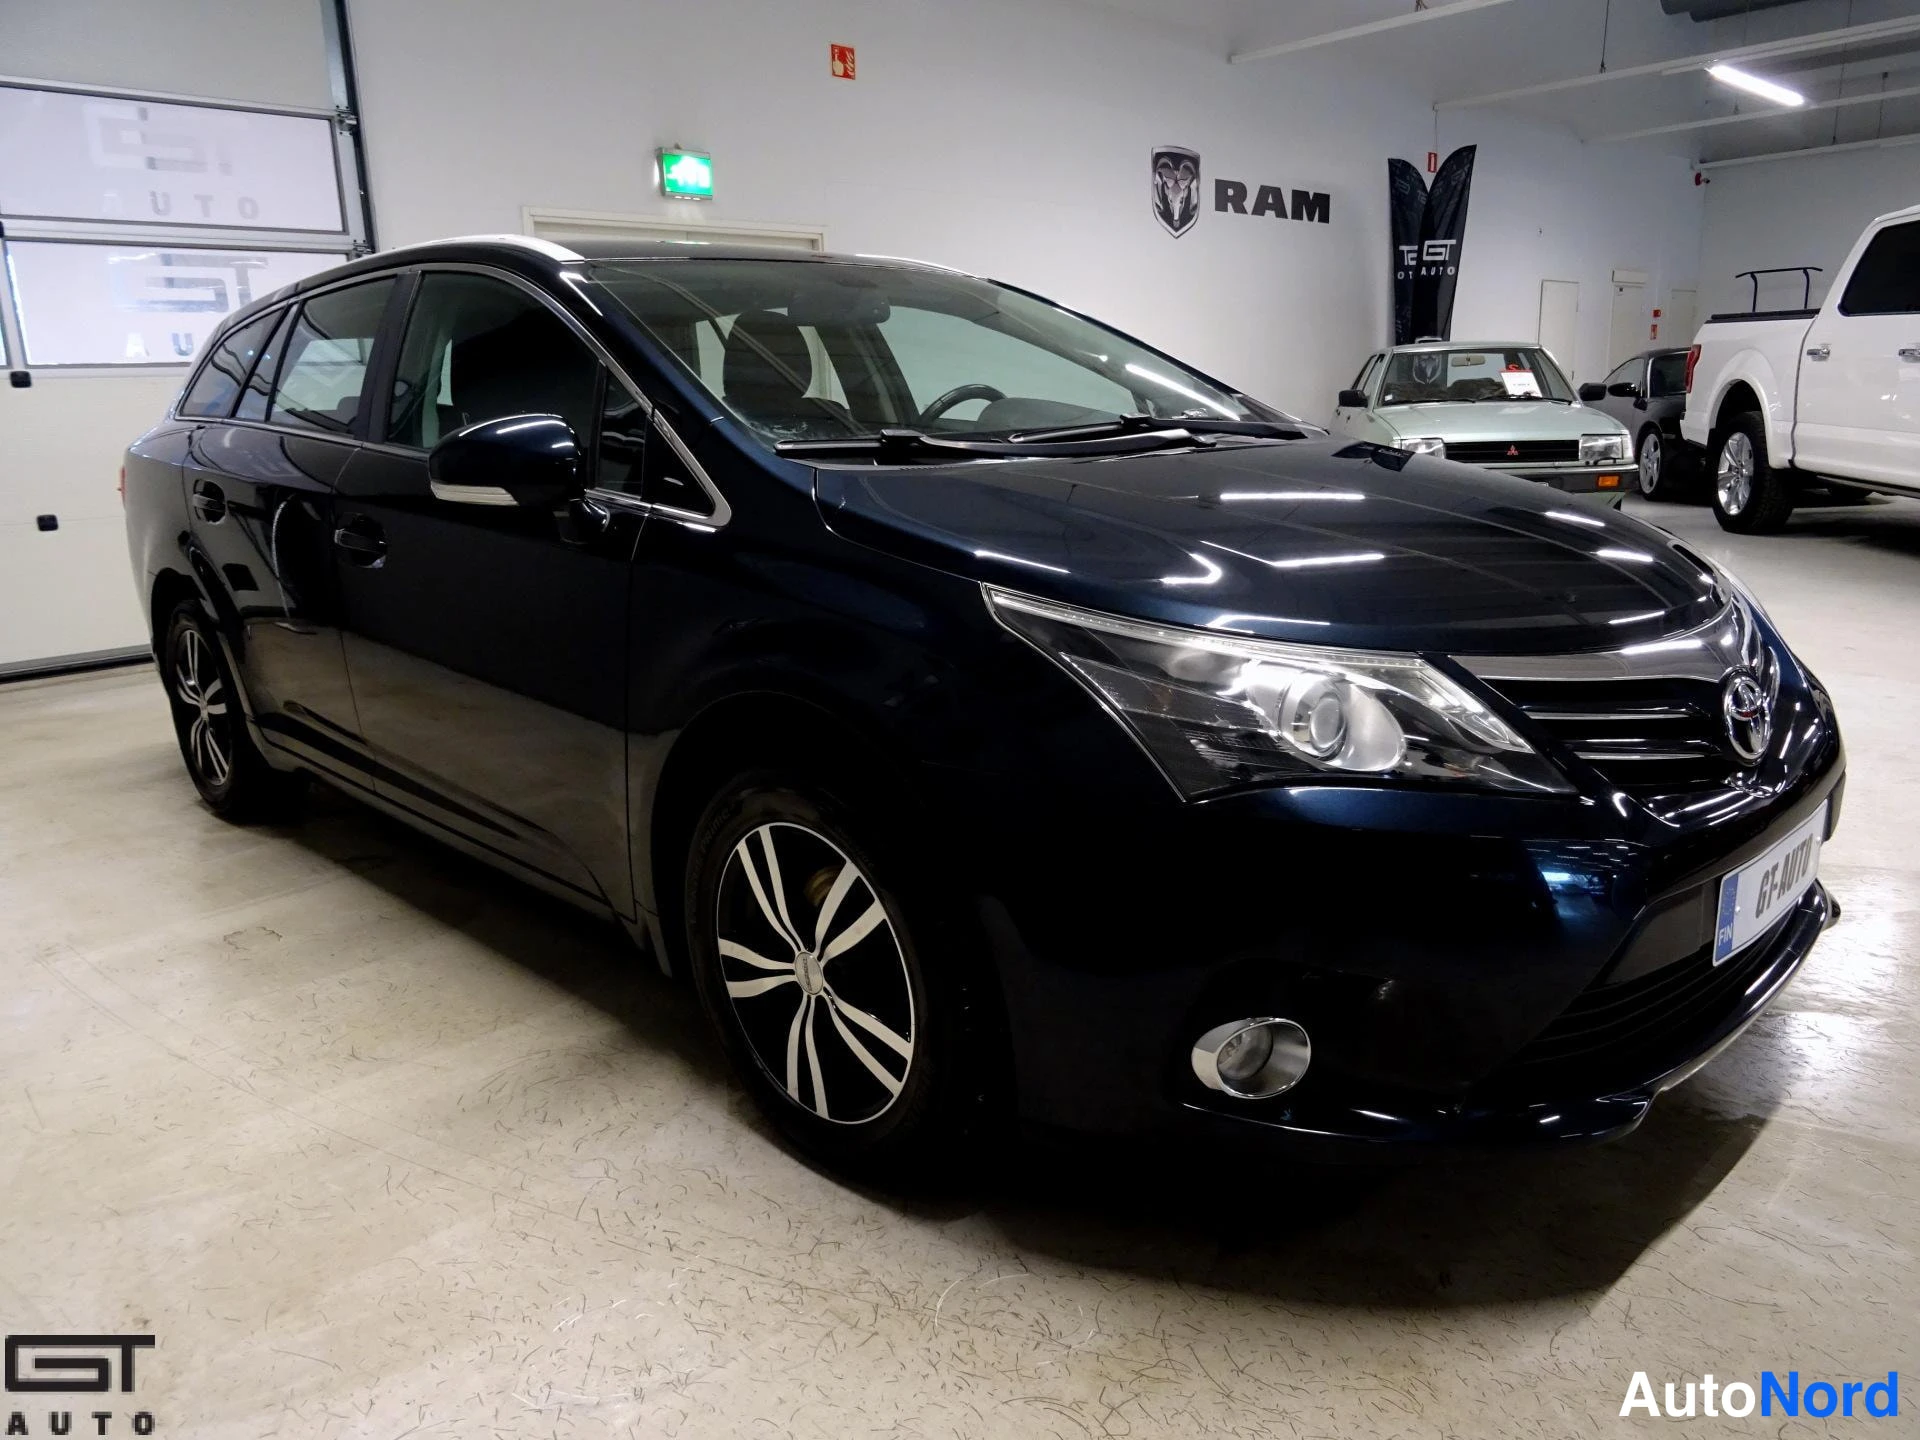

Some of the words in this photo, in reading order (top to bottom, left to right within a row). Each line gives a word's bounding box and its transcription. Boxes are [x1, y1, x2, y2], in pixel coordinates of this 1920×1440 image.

[1215, 178, 1330, 224] RAM
[1421, 266, 1456, 276] AUTO
[1755, 833, 1814, 919] GT-AUTO
[1718, 924, 1733, 947] FIN
